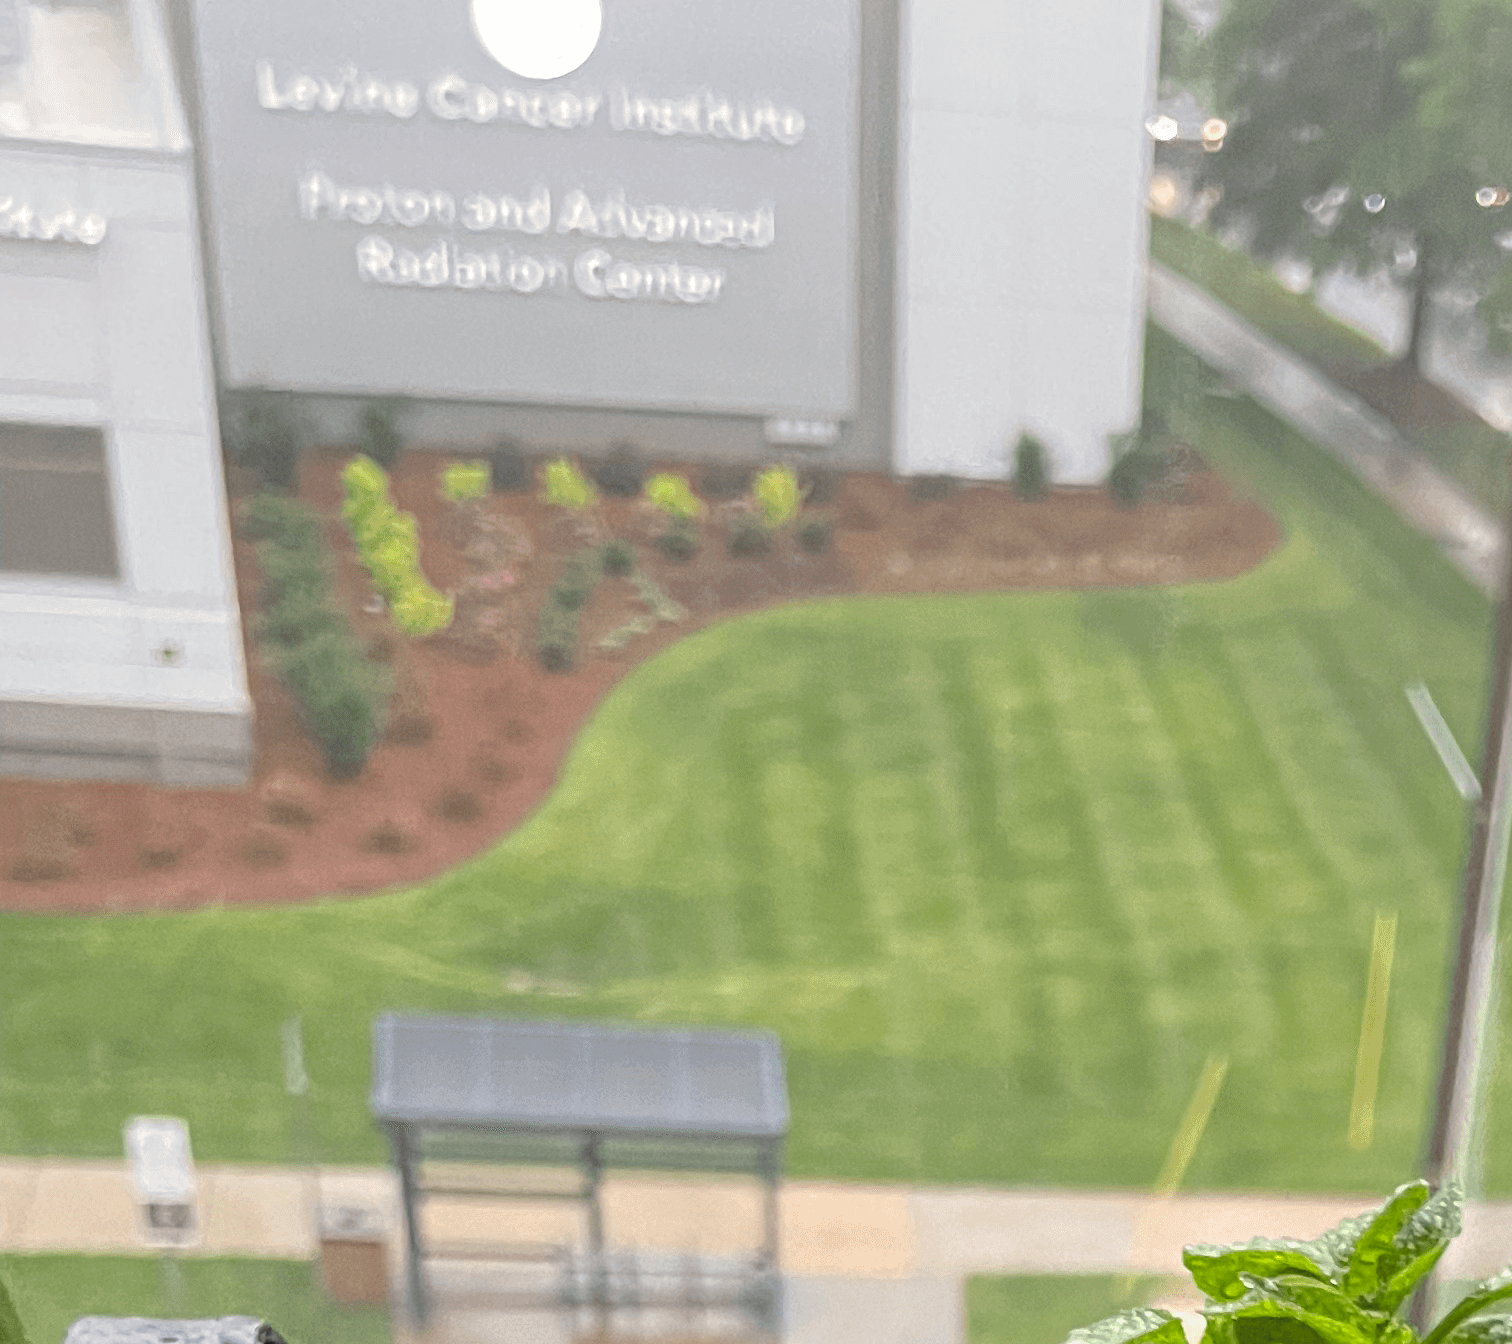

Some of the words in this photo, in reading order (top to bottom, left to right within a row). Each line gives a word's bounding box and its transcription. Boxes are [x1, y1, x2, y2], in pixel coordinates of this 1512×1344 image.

[255, 57, 420, 119] Levine
[426, 73, 601, 130] Cancer
[607, 85, 806, 145] Institute
[297, 168, 457, 228] Proton
[460, 184, 551, 235] and
[555, 187, 775, 248] Advanced
[355, 235, 568, 293] Radiation
[573, 248, 727, 303] Center
